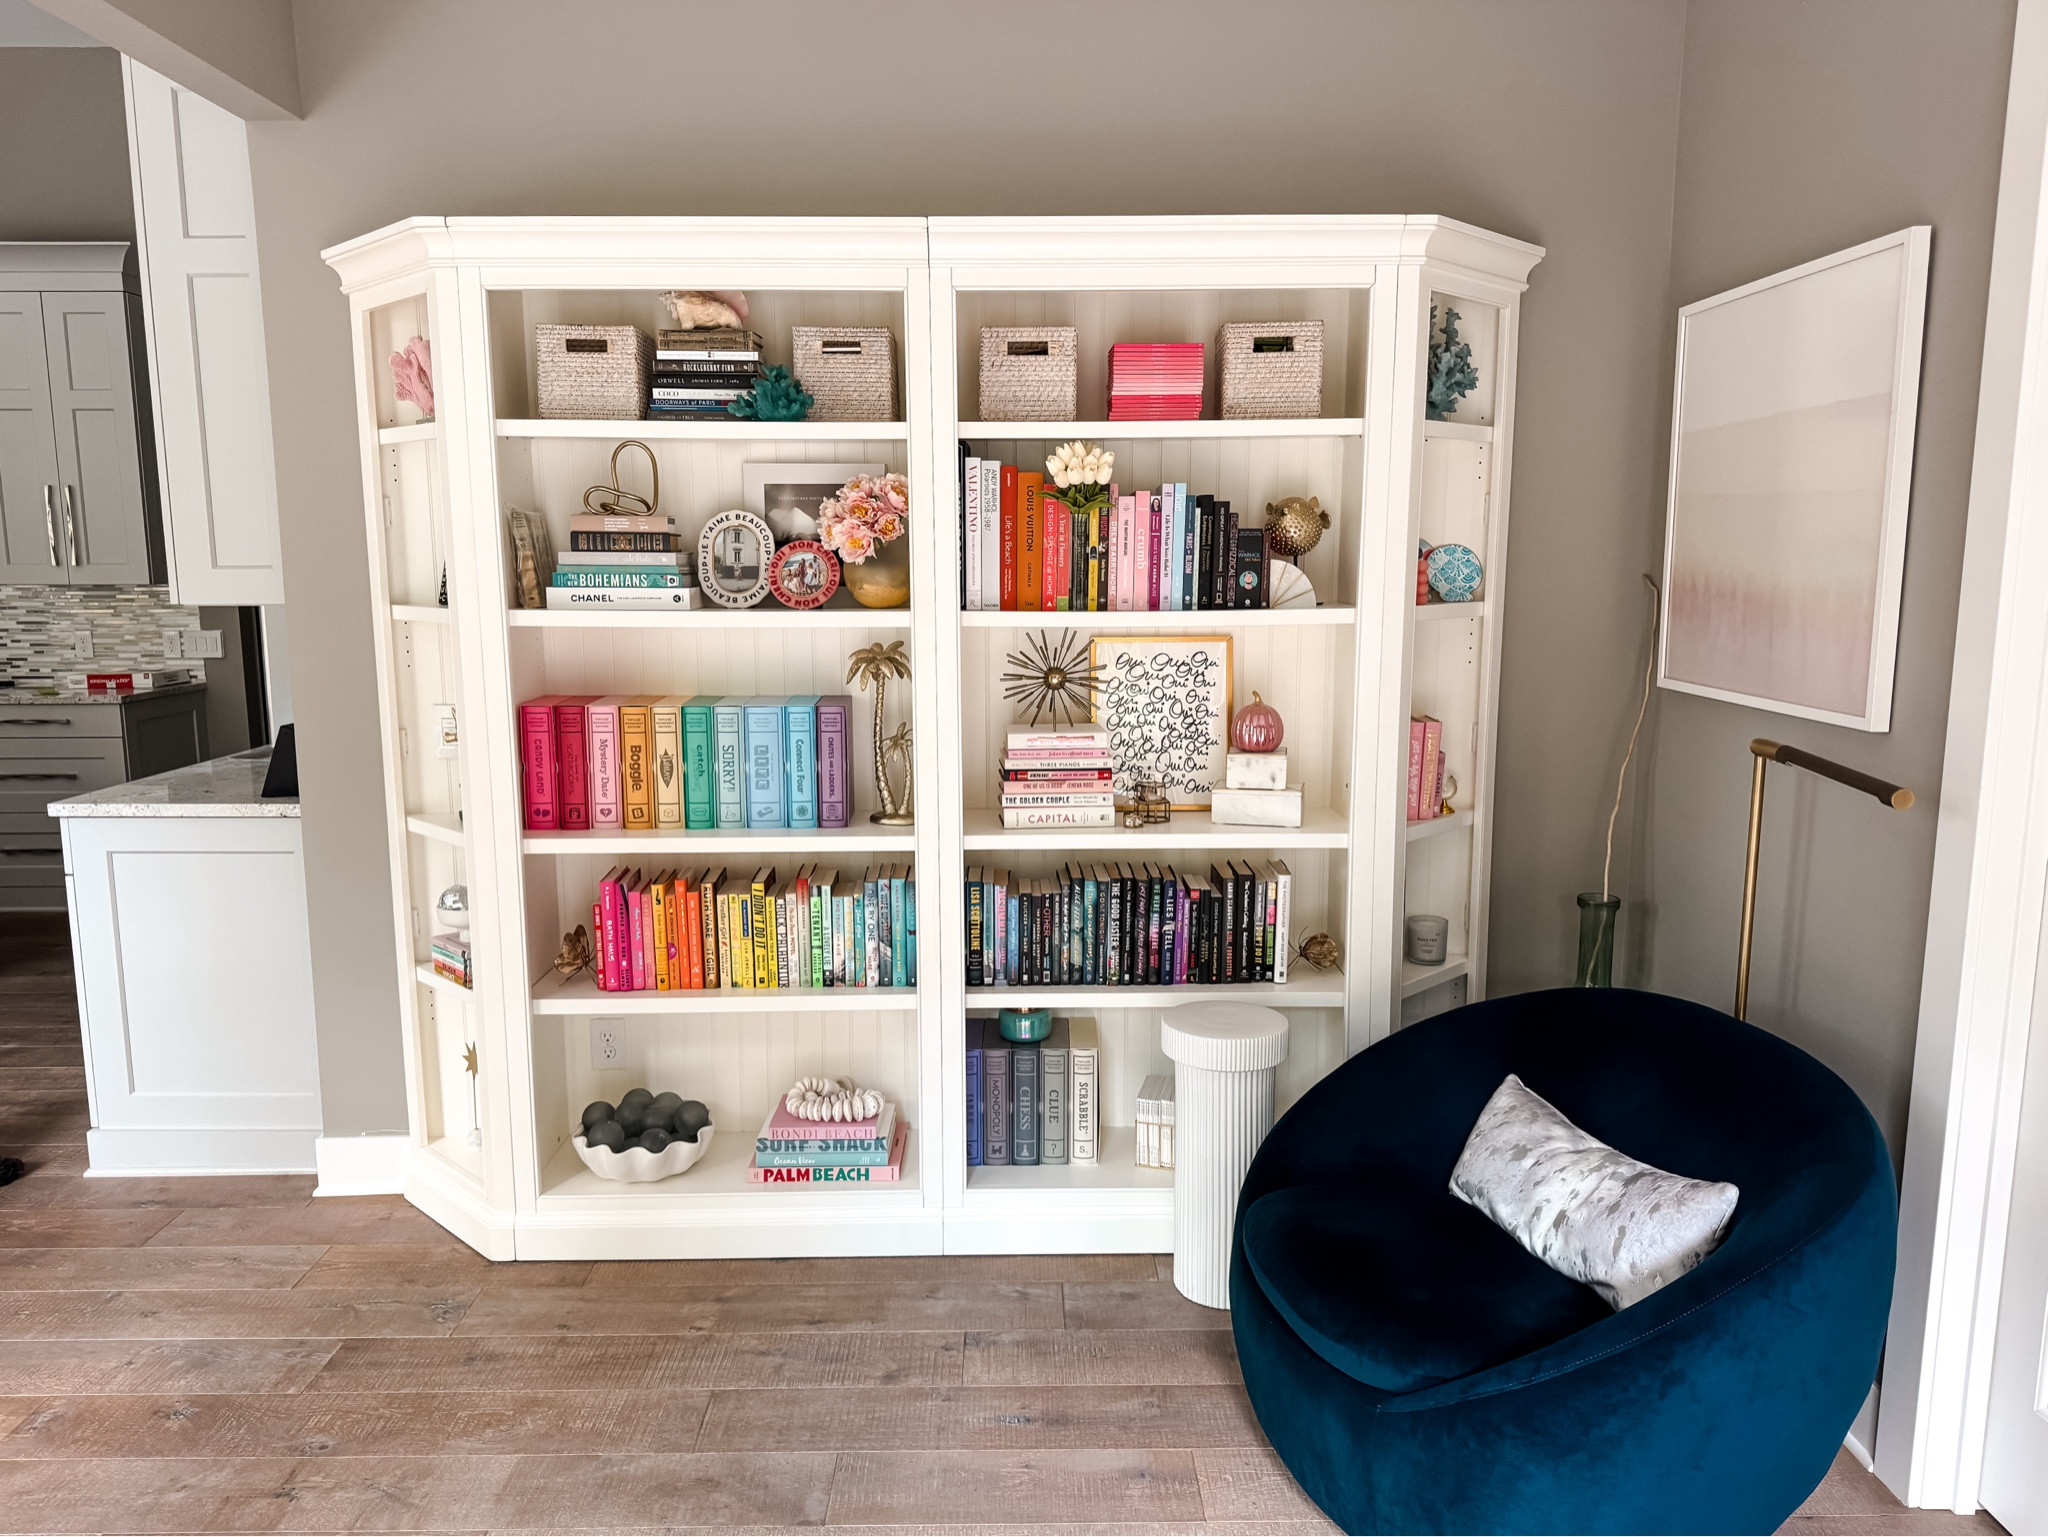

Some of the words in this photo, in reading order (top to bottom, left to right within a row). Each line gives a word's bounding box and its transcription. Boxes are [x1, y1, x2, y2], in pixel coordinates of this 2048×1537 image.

[722, 364, 734, 372] FINN
[968, 465, 978, 532] VALENTINO
[703, 514, 731, 540] T'AIME
[736, 514, 771, 556] BEAUCOUP
[702, 544, 708, 555] JE
[772, 550, 786, 568] OUI
[788, 542, 814, 551] MON
[816, 546, 838, 572] CHERI
[1138, 528, 1149, 569] crumb
[1229, 548, 1238, 576] FIZZICAL
[580, 574, 647, 587] BOHEMIANS
[702, 561, 738, 603] BEAUCOUP
[769, 576, 791, 603] CHERI
[823, 580, 836, 597] OUI
[570, 594, 614, 602] CHANEL
[795, 597, 820, 606] MON
[1162, 674, 1189, 689] Oui
[1193, 674, 1216, 688] Oui
[1149, 686, 1176, 704] Oui
[1186, 689, 1210, 704] Oui
[1142, 702, 1164, 716] Oui
[1137, 714, 1156, 727] Oui
[1159, 716, 1176, 732] Oui
[1110, 732, 1136, 750] Oui
[599, 739, 608, 775] Mystery
[696, 744, 705, 777] catch
[796, 739, 804, 772] Connect
[1124, 746, 1146, 762] Oui
[1155, 751, 1183, 773] Oui
[1184, 757, 1208, 772] Oui
[630, 745, 643, 791] Boggle
[722, 745, 735, 791] SORRY!
[754, 745, 770, 790] LIFE
[1184, 779, 1213, 794] Oui
[1028, 814, 1076, 824] CAPITAL
[971, 887, 980, 904] LISA
[1112, 882, 1120, 896] THE
[1154, 884, 1160, 893] WE
[754, 895, 765, 924] DIDN'T
[868, 910, 874, 920] BY
[998, 887, 1006, 938] INSOMNIA
[1112, 898, 1120, 919] GOOD
[755, 926, 765, 939] DO
[812, 910, 820, 942] TENANT
[971, 905, 980, 950] SCOTTOLINE
[1111, 920, 1120, 946] SISTER
[756, 941, 765, 950] IT
[1165, 930, 1173, 950] TELL
[707, 948, 714, 957] IT
[1255, 948, 1262, 956] DO
[992, 1079, 1000, 1135] MONOPOLY
[1020, 1086, 1030, 1130] CHESS
[1049, 1090, 1059, 1123] CLUE
[1079, 1082, 1088, 1131] SCRABBLE
[772, 1130, 818, 1139] BONDI
[825, 1129, 873, 1139] BEACH
[756, 1138, 809, 1152] SURF
[818, 1136, 886, 1151] SHACK
[774, 1156, 797, 1165] Ocean
[798, 1156, 816, 1164] View
[763, 1168, 810, 1182] PALM
[813, 1168, 870, 1181] BEACH
